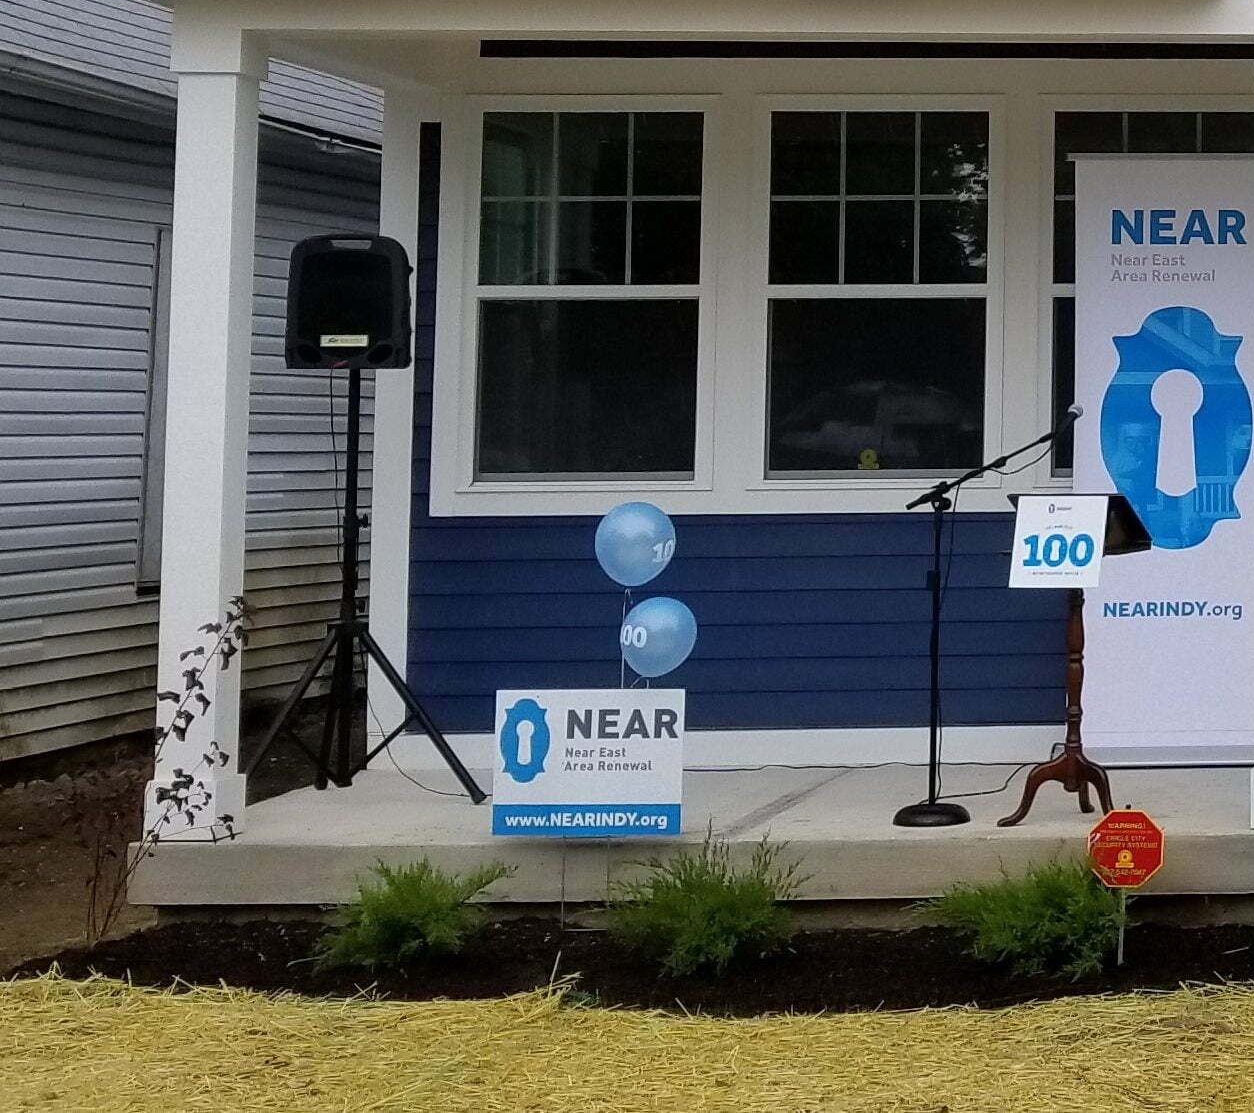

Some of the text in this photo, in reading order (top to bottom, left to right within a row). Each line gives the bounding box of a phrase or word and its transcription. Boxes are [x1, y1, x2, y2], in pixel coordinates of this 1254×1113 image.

[1111, 209, 1247, 245] NEAR
[1111, 253, 1186, 267] Near East
[1111, 269, 1216, 282] Area Renewal
[1023, 533, 1095, 567] 100
[1103, 601, 1243, 620] NEARINDY.org
[566, 708, 679, 740] NEAR
[565, 747, 626, 758] Near East
[564, 760, 652, 772] Area Renewal
[505, 812, 668, 829] www.NEARINDY.org
